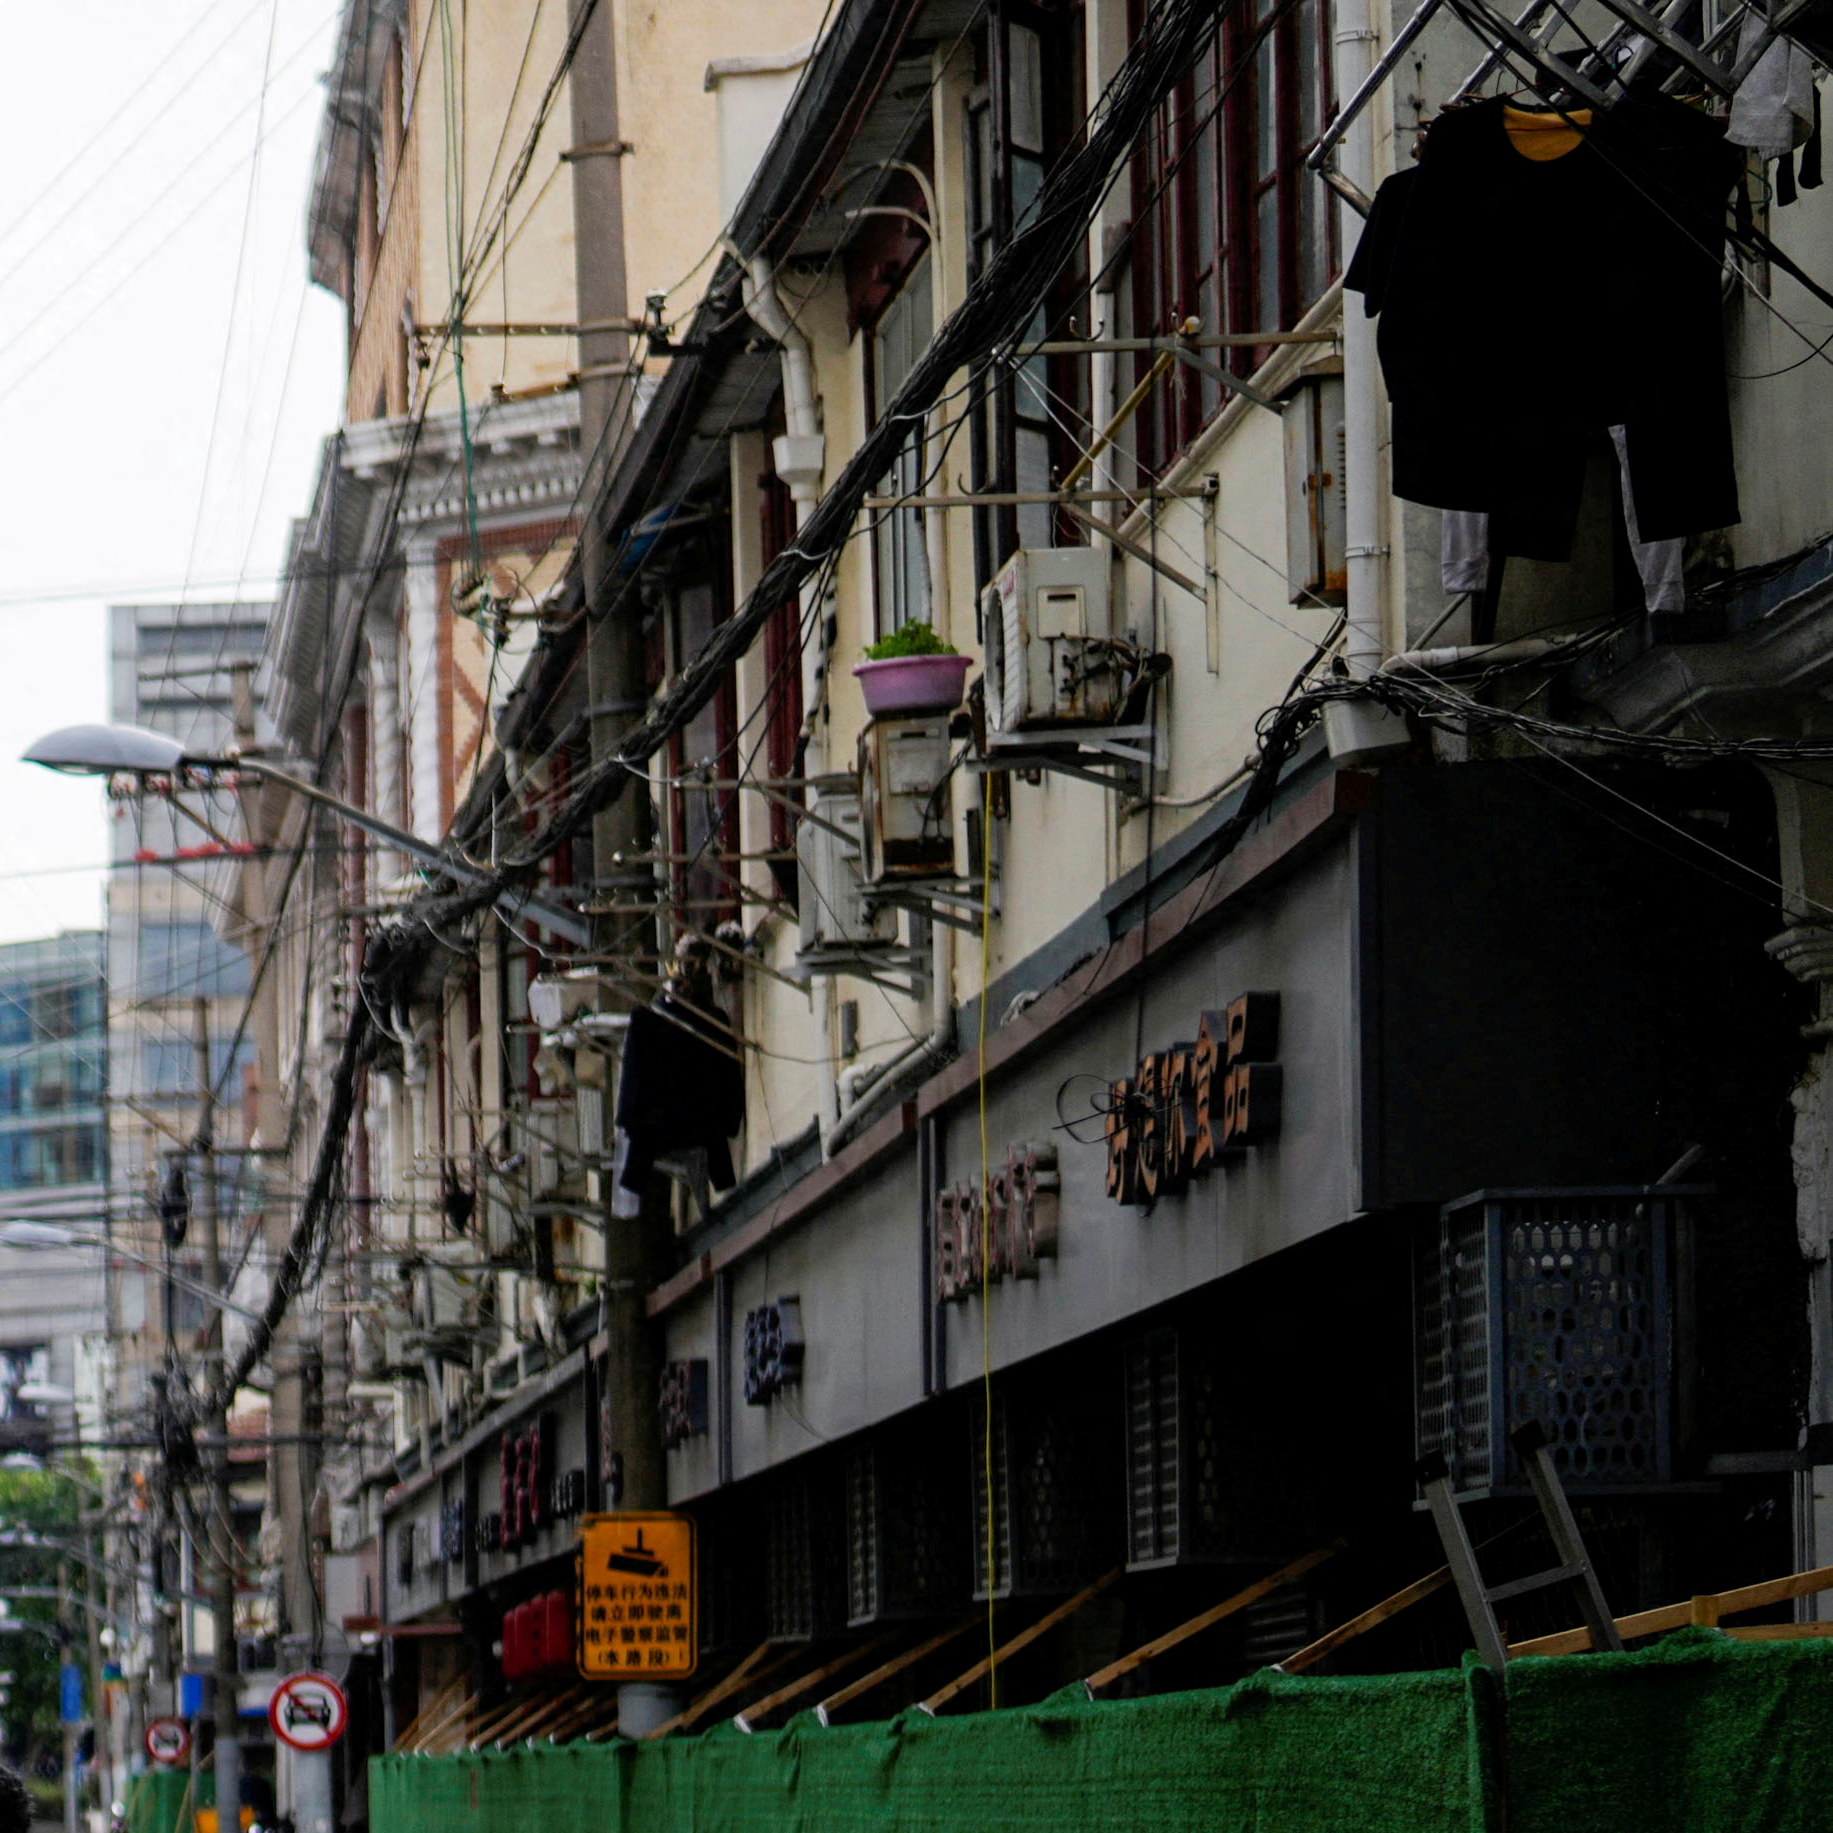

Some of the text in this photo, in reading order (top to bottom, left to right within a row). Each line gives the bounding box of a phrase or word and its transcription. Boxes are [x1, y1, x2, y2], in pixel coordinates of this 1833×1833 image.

[586, 1583, 688, 1601] 停车行为违法
[590, 1604, 682, 1622] 请立即驶离
